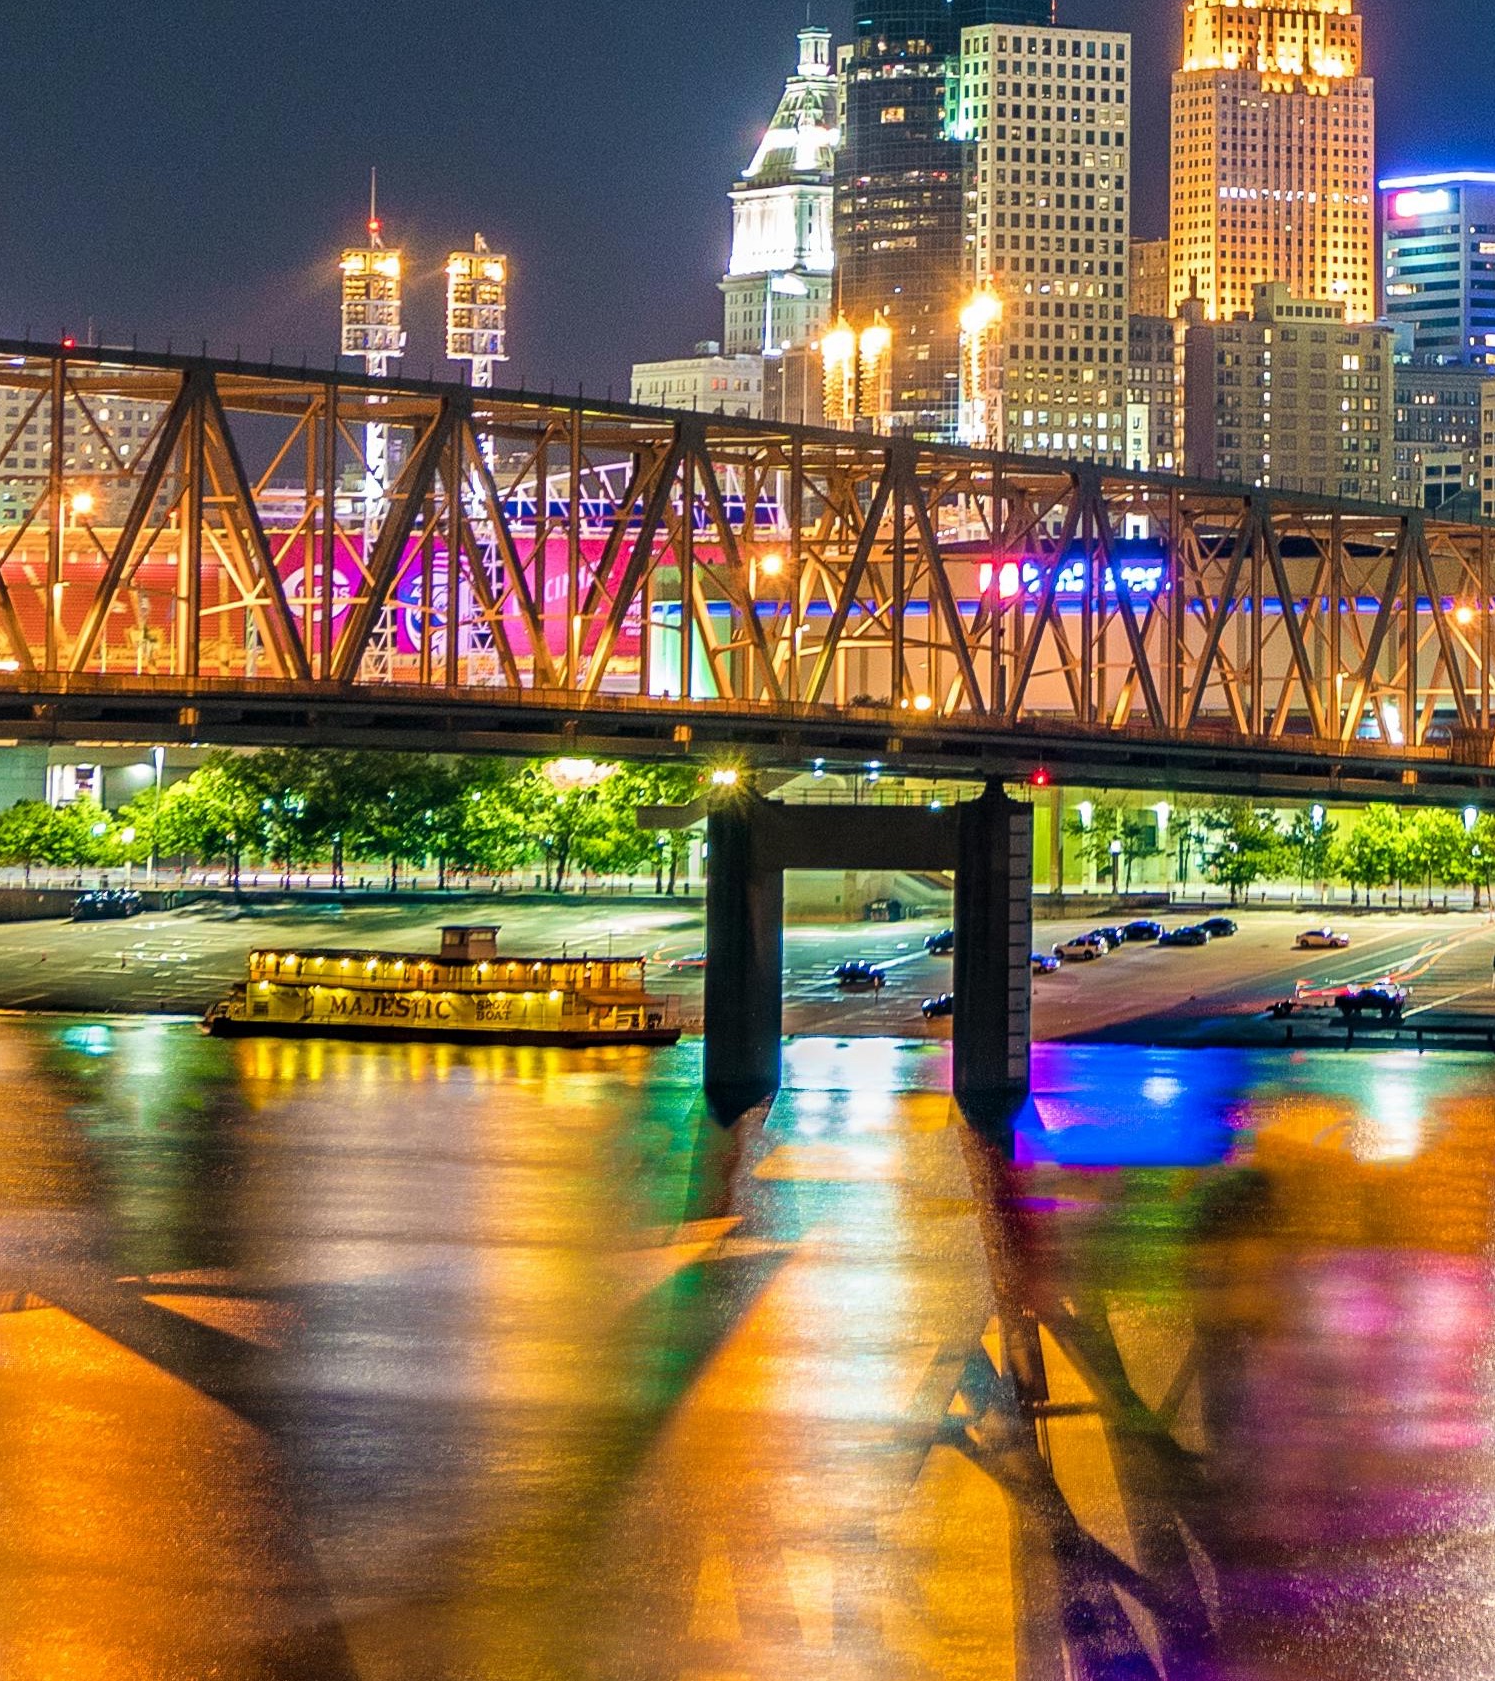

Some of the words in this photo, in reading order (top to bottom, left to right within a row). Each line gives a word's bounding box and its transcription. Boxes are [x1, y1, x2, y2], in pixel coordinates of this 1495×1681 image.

[330, 995, 451, 1020] MAJESTIC
[475, 999, 512, 1011] SHOW
[475, 1010, 512, 1021] BOAT
